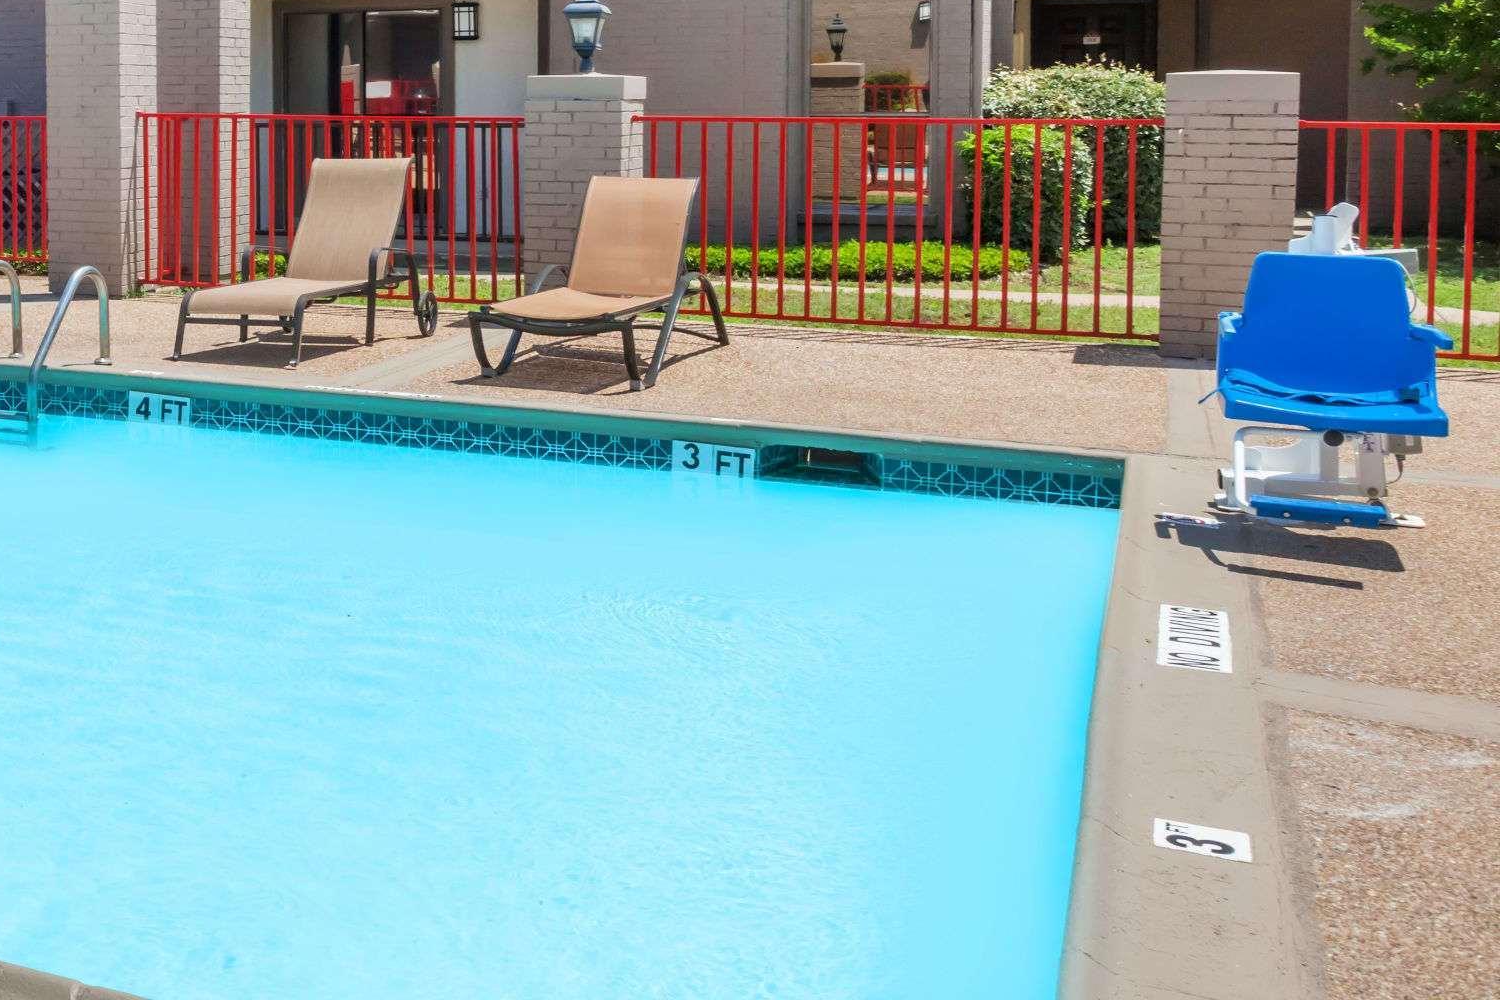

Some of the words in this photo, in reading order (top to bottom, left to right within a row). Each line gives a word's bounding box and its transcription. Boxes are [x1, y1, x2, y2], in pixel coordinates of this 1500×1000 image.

[136, 397, 151, 421] 4
[161, 400, 188, 425] FT
[682, 443, 699, 469] 3
[716, 450, 751, 479] FT
[1168, 607, 1221, 648] DIVING
[1167, 652, 1221, 671] NO
[1165, 834, 1235, 855] 3
